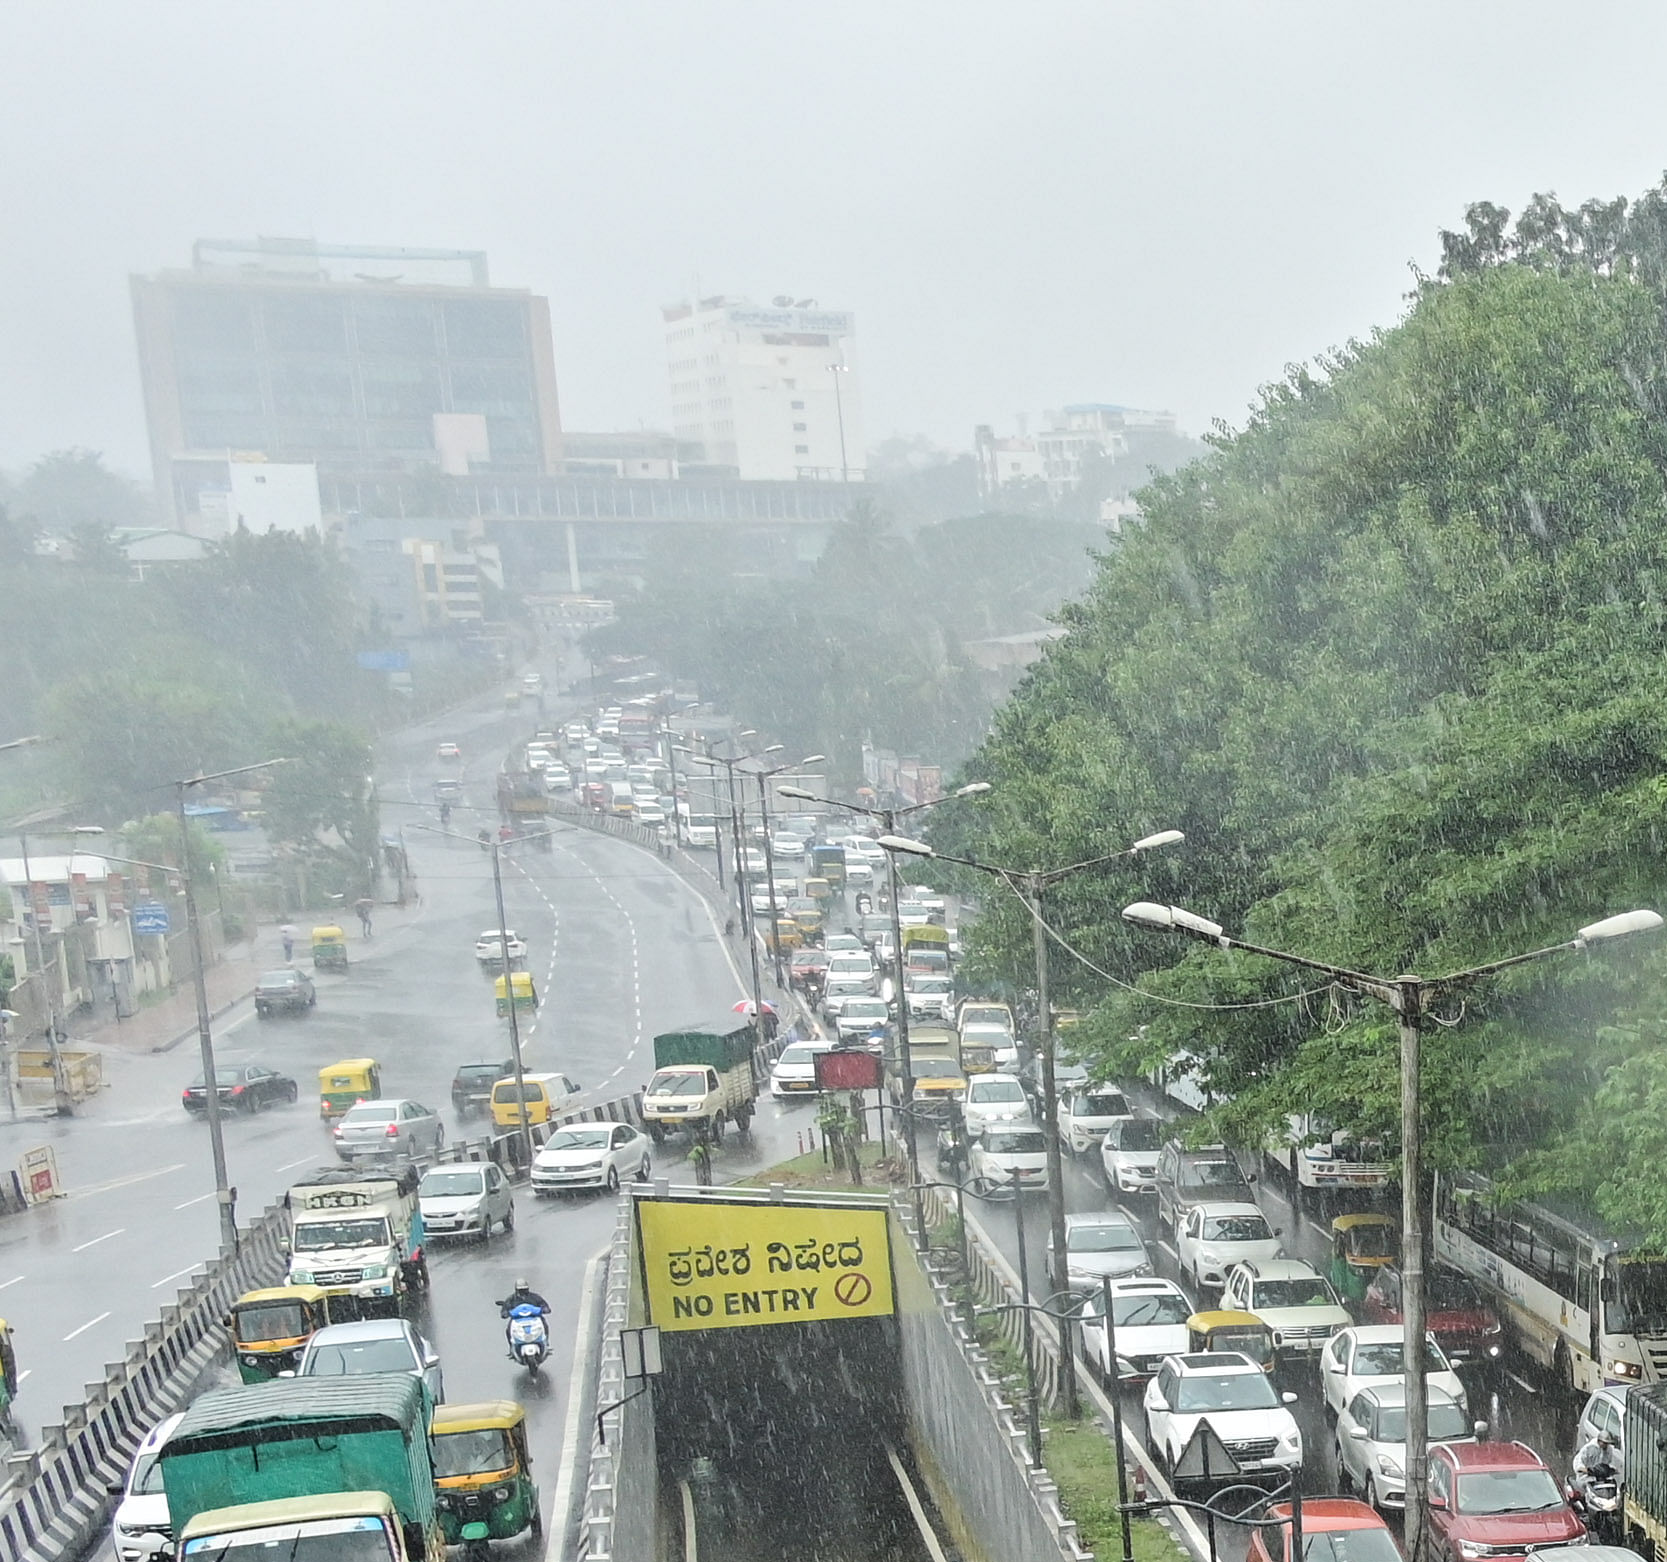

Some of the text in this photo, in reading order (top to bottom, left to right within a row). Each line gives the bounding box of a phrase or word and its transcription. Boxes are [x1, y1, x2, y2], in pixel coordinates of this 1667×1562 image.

[668, 1243, 751, 1286] ಪ್ರವೇಶ
[673, 1287, 818, 1318] NO ENTRY
